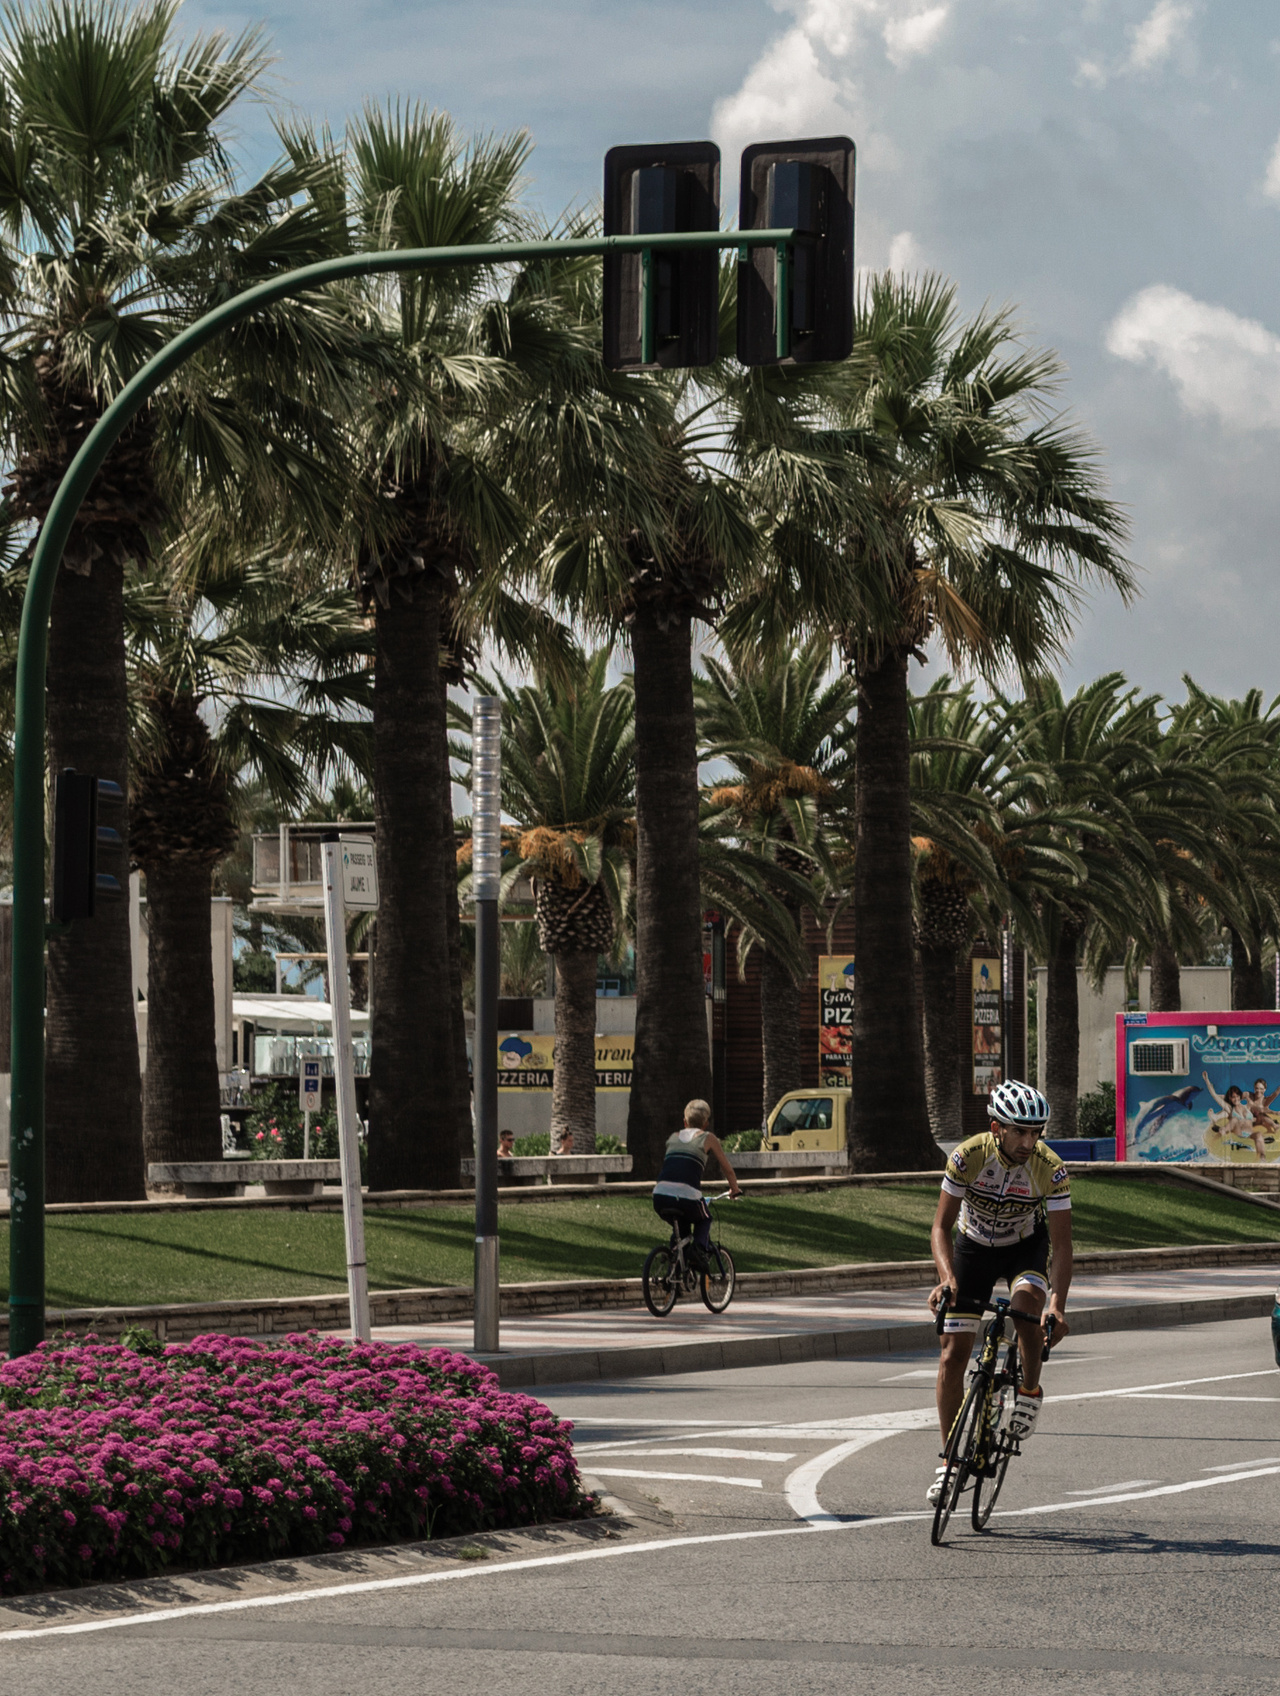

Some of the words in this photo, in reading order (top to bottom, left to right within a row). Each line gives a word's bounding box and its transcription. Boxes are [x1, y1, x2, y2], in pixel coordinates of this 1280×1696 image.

[824, 1007, 854, 1023] PIZ
[1051, 1167, 1068, 1183] GU
[974, 1181, 1000, 1190] POLAR
